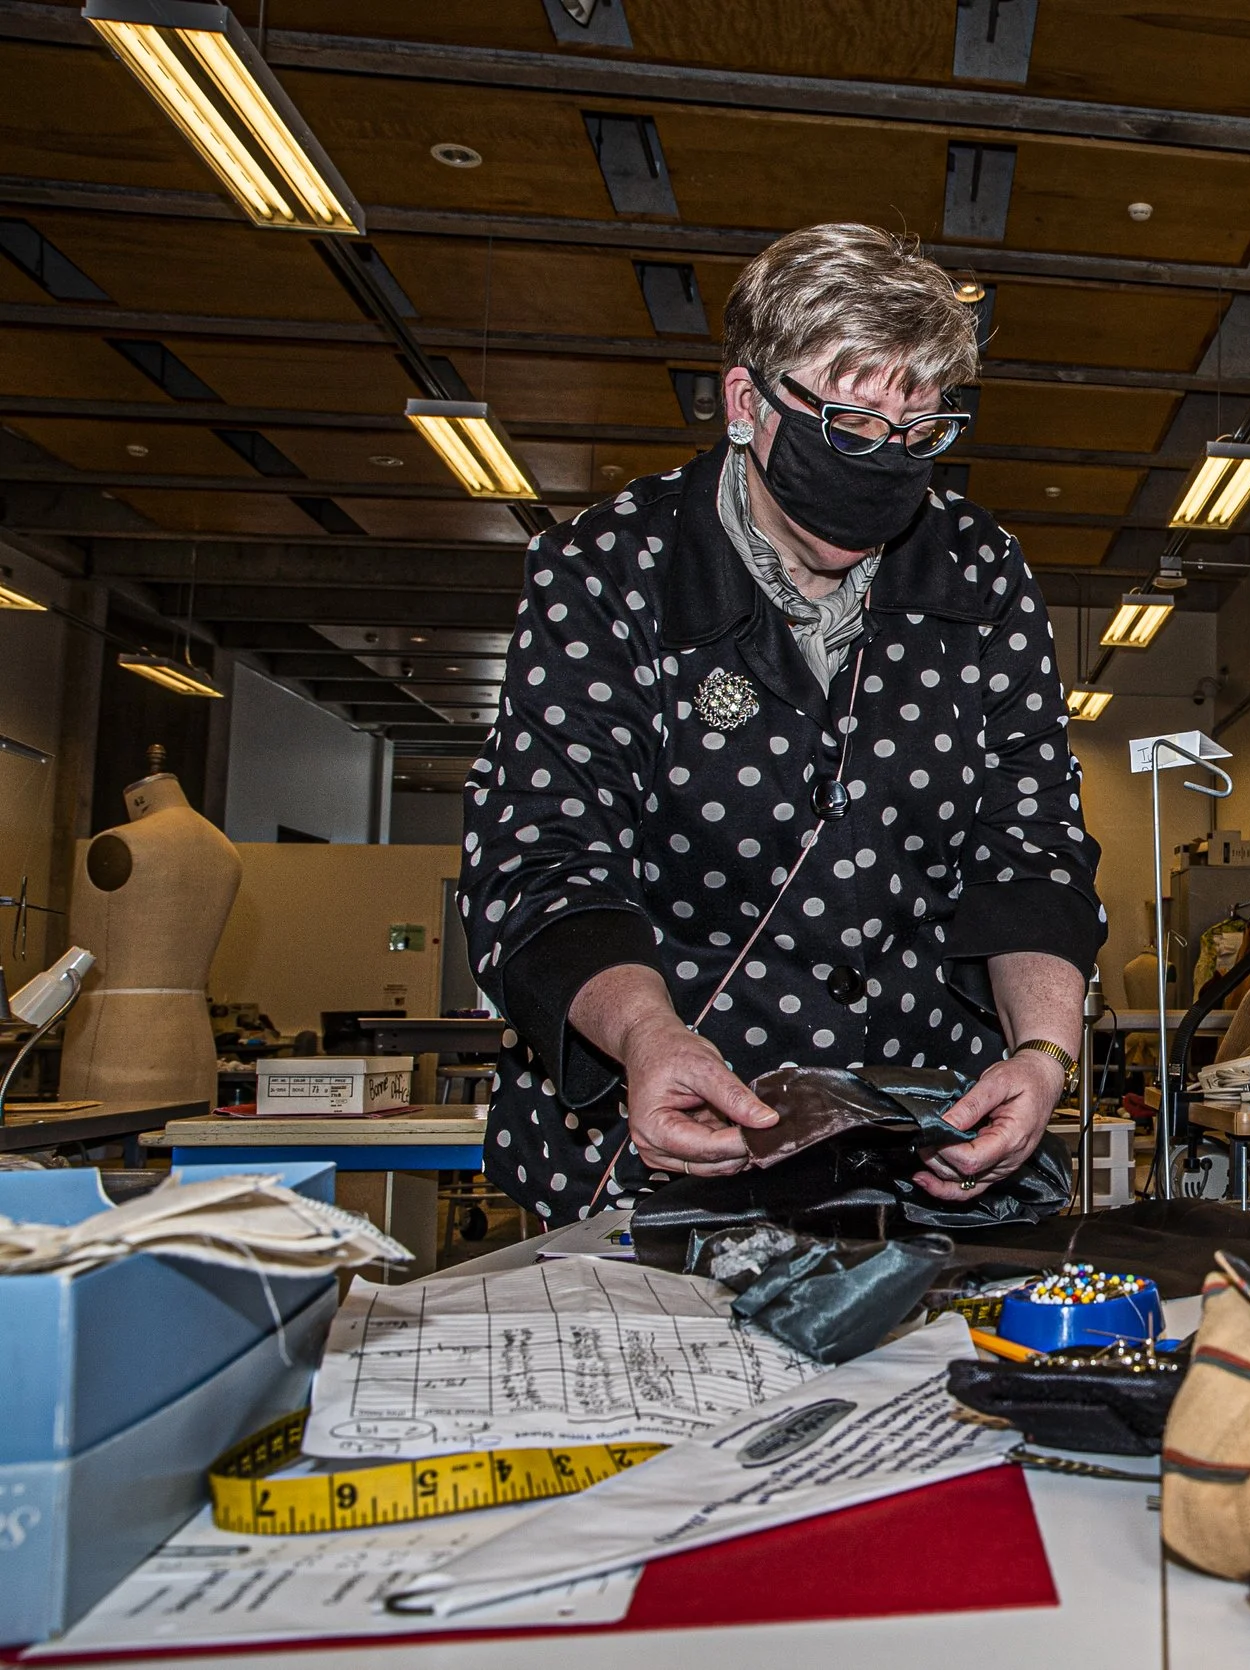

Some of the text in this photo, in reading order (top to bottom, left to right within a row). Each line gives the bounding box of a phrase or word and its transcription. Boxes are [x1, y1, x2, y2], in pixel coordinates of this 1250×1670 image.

[494, 1458, 513, 1484] 4
[553, 1454, 576, 1478] 3
[615, 1448, 634, 1468] 2
[336, 1482, 358, 1509] 6
[417, 1468, 438, 1497] 5
[255, 1489, 276, 1517] 7
